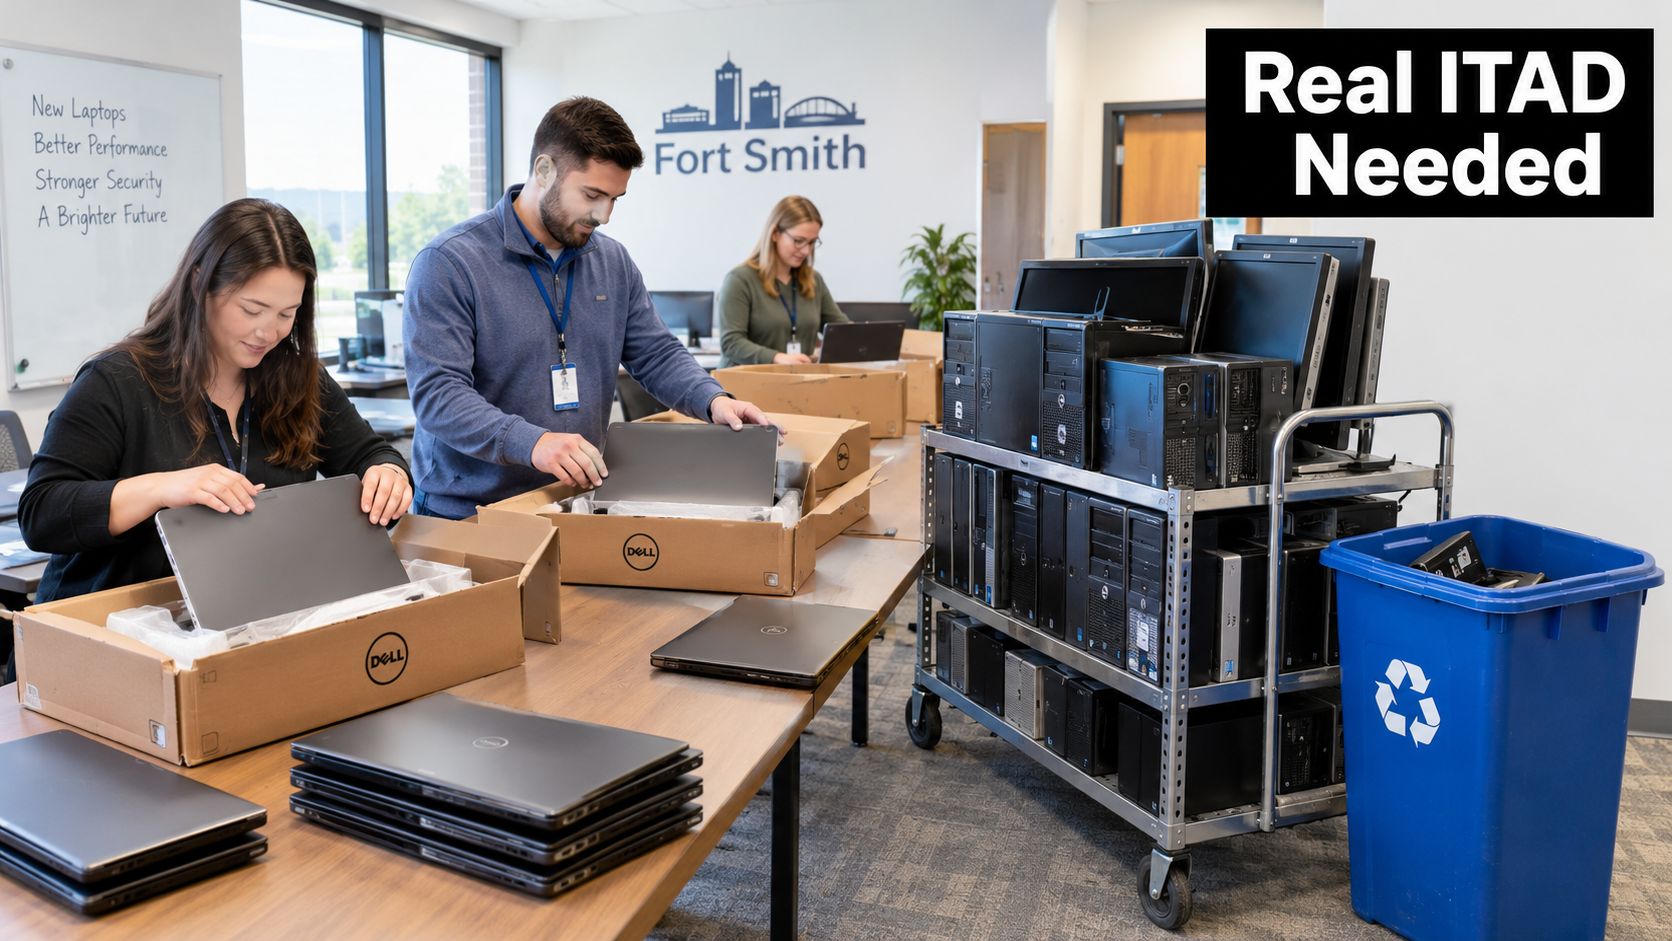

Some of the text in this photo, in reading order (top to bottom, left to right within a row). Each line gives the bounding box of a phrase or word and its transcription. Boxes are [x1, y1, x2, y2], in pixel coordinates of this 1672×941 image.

[32, 94, 126, 128] New Laptops
[34, 131, 168, 158] Better Performance
[655, 134, 866, 175] Fort Smith
[35, 168, 162, 199] Stronger Security
[38, 203, 168, 235] A Brighter Future
[627, 547, 655, 557] DELL
[371, 649, 404, 669] DELL
